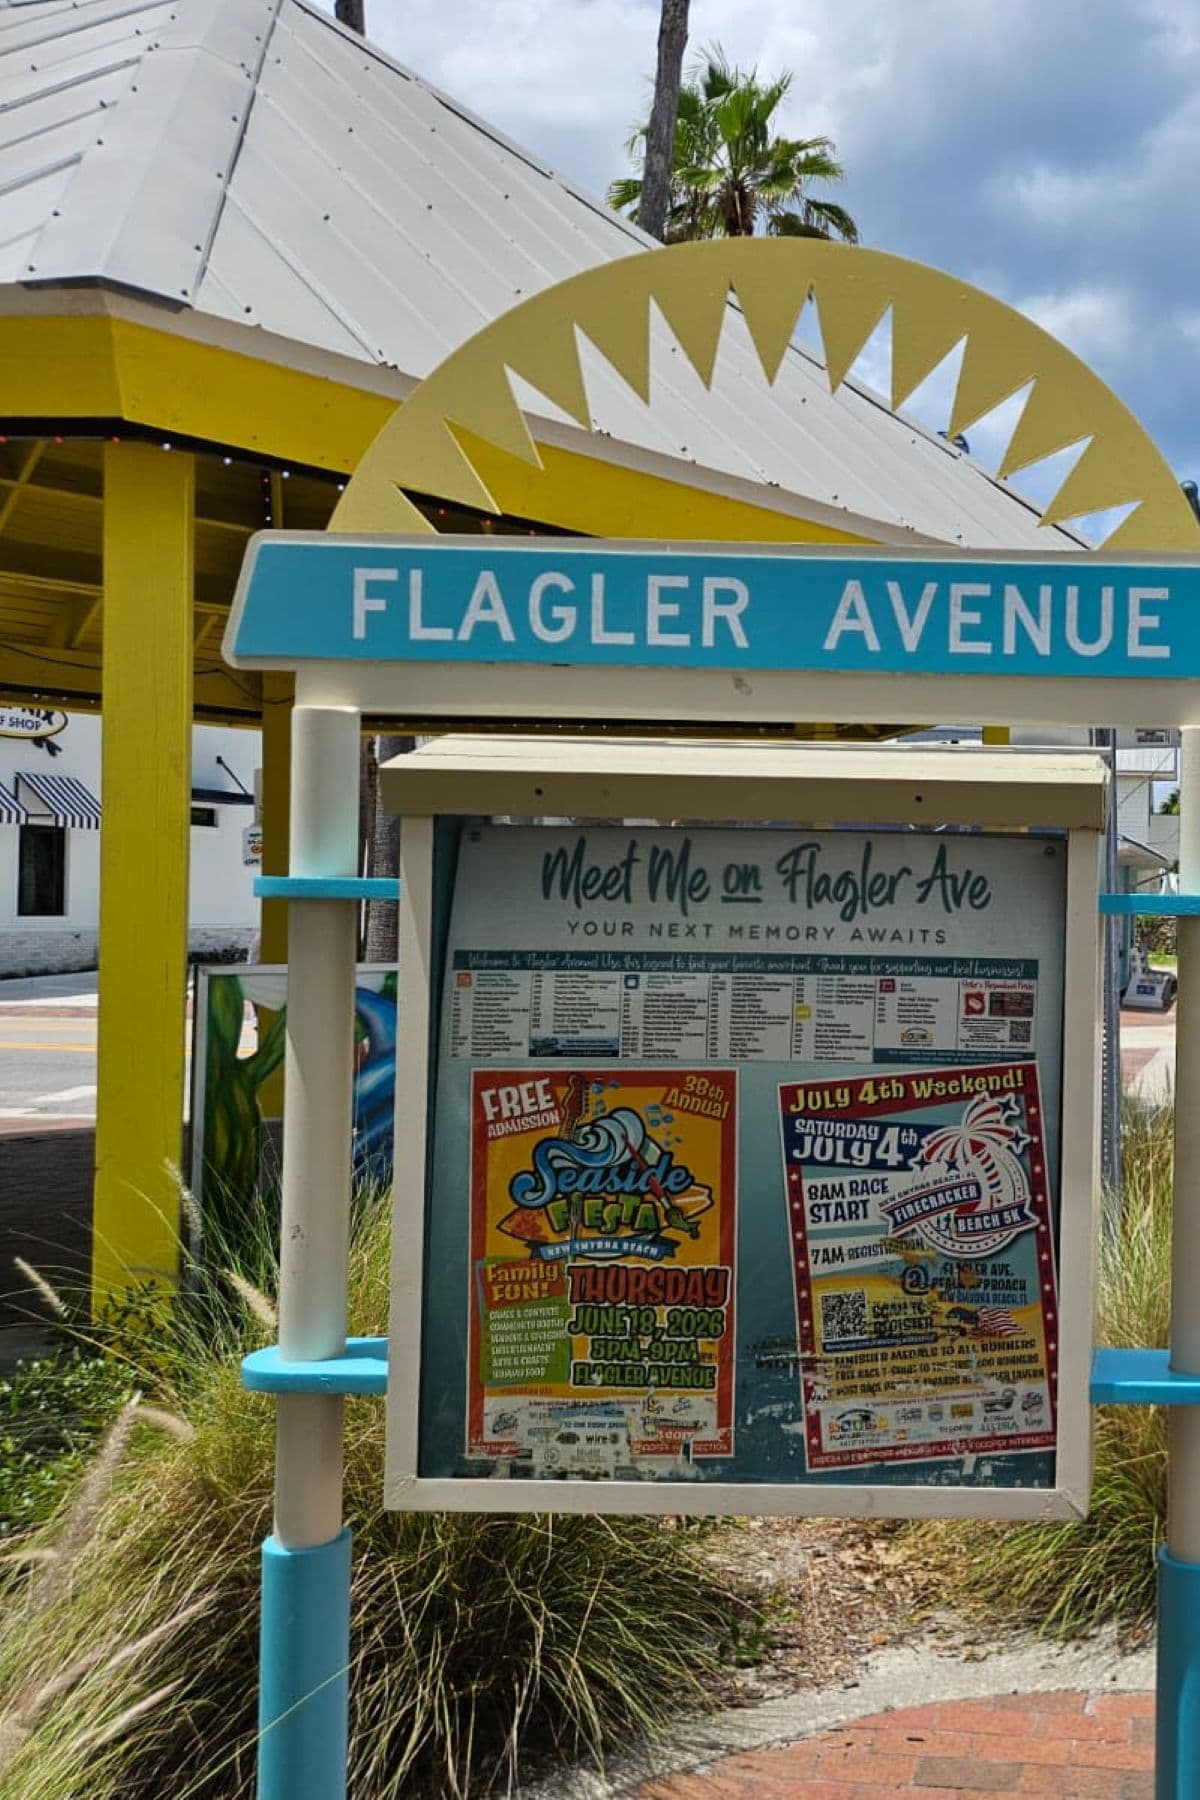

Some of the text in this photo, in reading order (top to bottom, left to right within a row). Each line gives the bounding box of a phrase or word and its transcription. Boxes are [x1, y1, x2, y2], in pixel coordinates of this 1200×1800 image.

[353, 567, 1173, 659] FLAGLER AVENUE
[8, 716, 42, 732] SHOP
[542, 836, 992, 922] Meet Me on Flagler Ave
[567, 921, 947, 944] YOUR NEXT MEMORY AWAITS
[481, 1079, 555, 1120] FREE
[684, 1076, 725, 1102] 38th
[858, 1081, 905, 1105] 4th
[910, 1069, 1025, 1099] Weekend!
[664, 1088, 729, 1119] Annual
[488, 1113, 560, 1138] ADMISSION
[794, 1118, 879, 1141] SATURDAY
[876, 1126, 917, 1166] 4th
[510, 1139, 692, 1208] Seaside
[808, 1178, 889, 1201] 8AM RACE
[809, 1200, 868, 1224] START
[894, 1184, 978, 1224] FIRECRACKER
[958, 1208, 1021, 1233] BEACH 5K
[811, 1246, 845, 1264] 7AM
[487, 1260, 559, 1284] Family
[493, 1281, 550, 1302] FUN!
[569, 1267, 728, 1307] THURSDAY
[570, 1306, 724, 1338] JUNE 18, 2026
[647, 1365, 715, 1388] AVENUE
